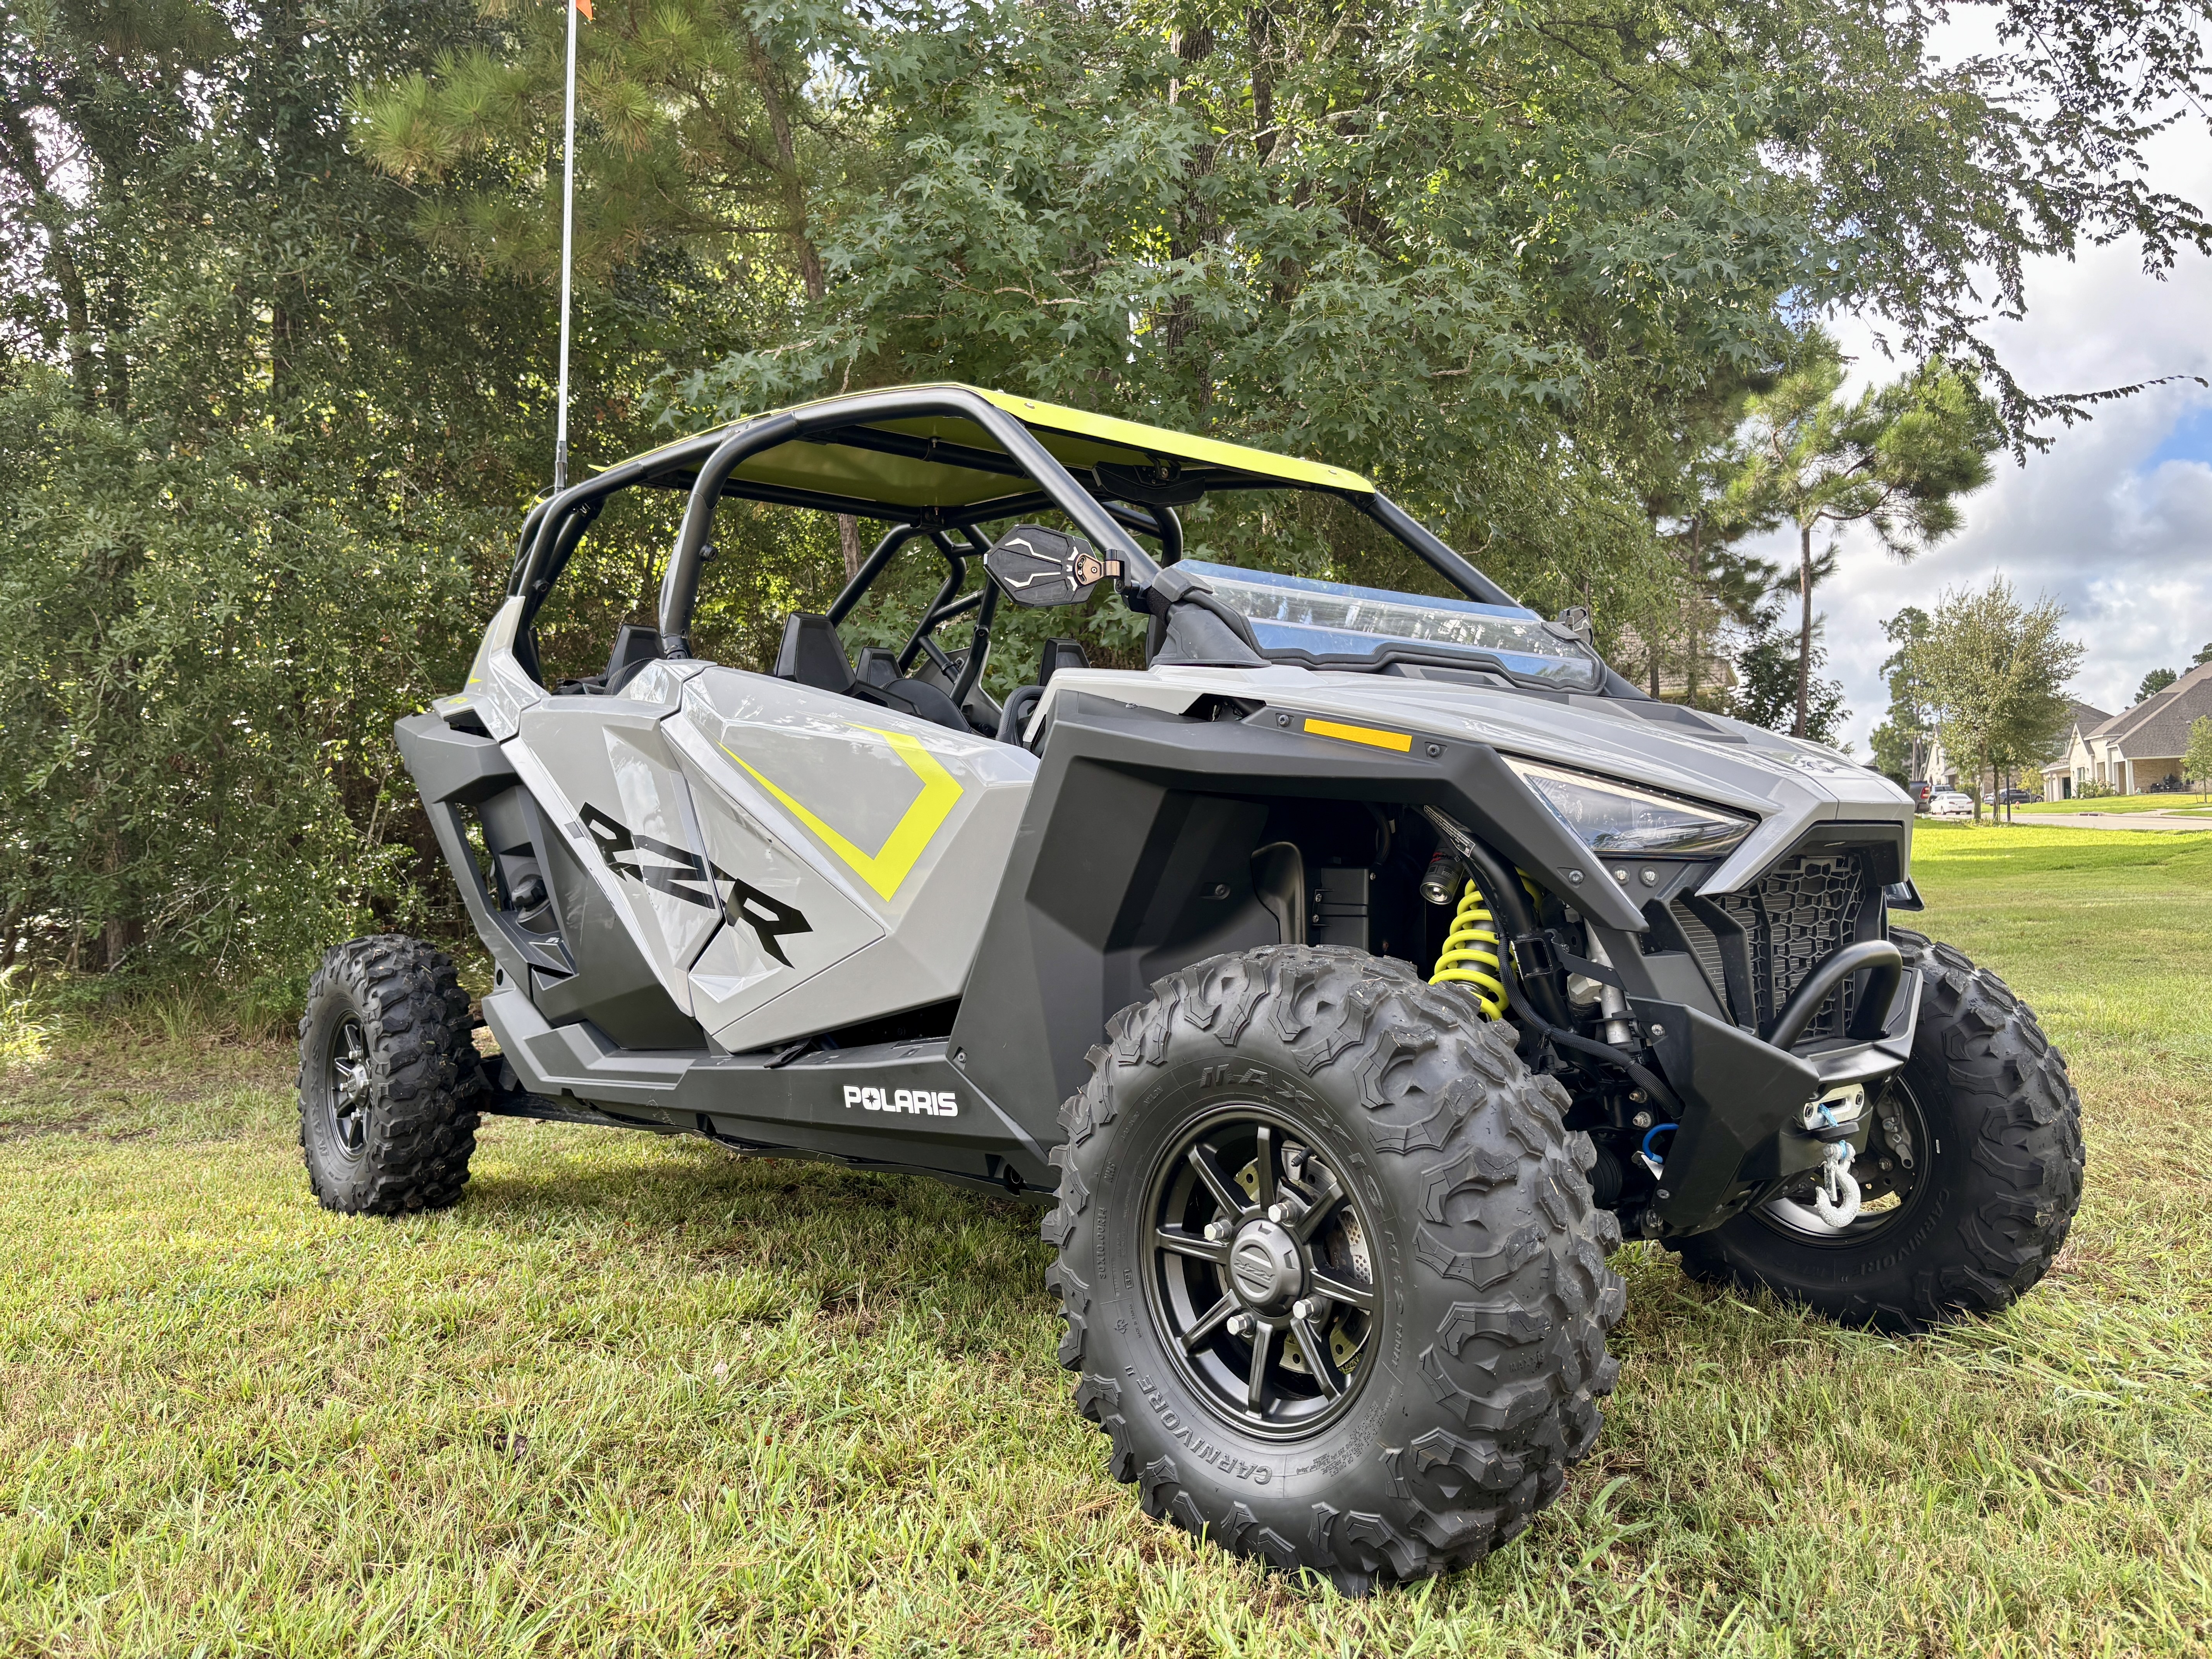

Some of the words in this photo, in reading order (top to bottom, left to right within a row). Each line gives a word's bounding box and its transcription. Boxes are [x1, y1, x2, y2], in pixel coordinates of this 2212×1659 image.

[579, 801, 814, 969] RZR
[843, 1085, 958, 1116] POLARIS
[1199, 1063, 1385, 1213] MAXXIS
[1104, 1162, 1116, 1183] NHS
[1097, 1207, 1107, 1279] 30X10.00R14
[1853, 1188, 1950, 1276] CARNIVORE
[1136, 1374, 1273, 1485] CARNIVORE
